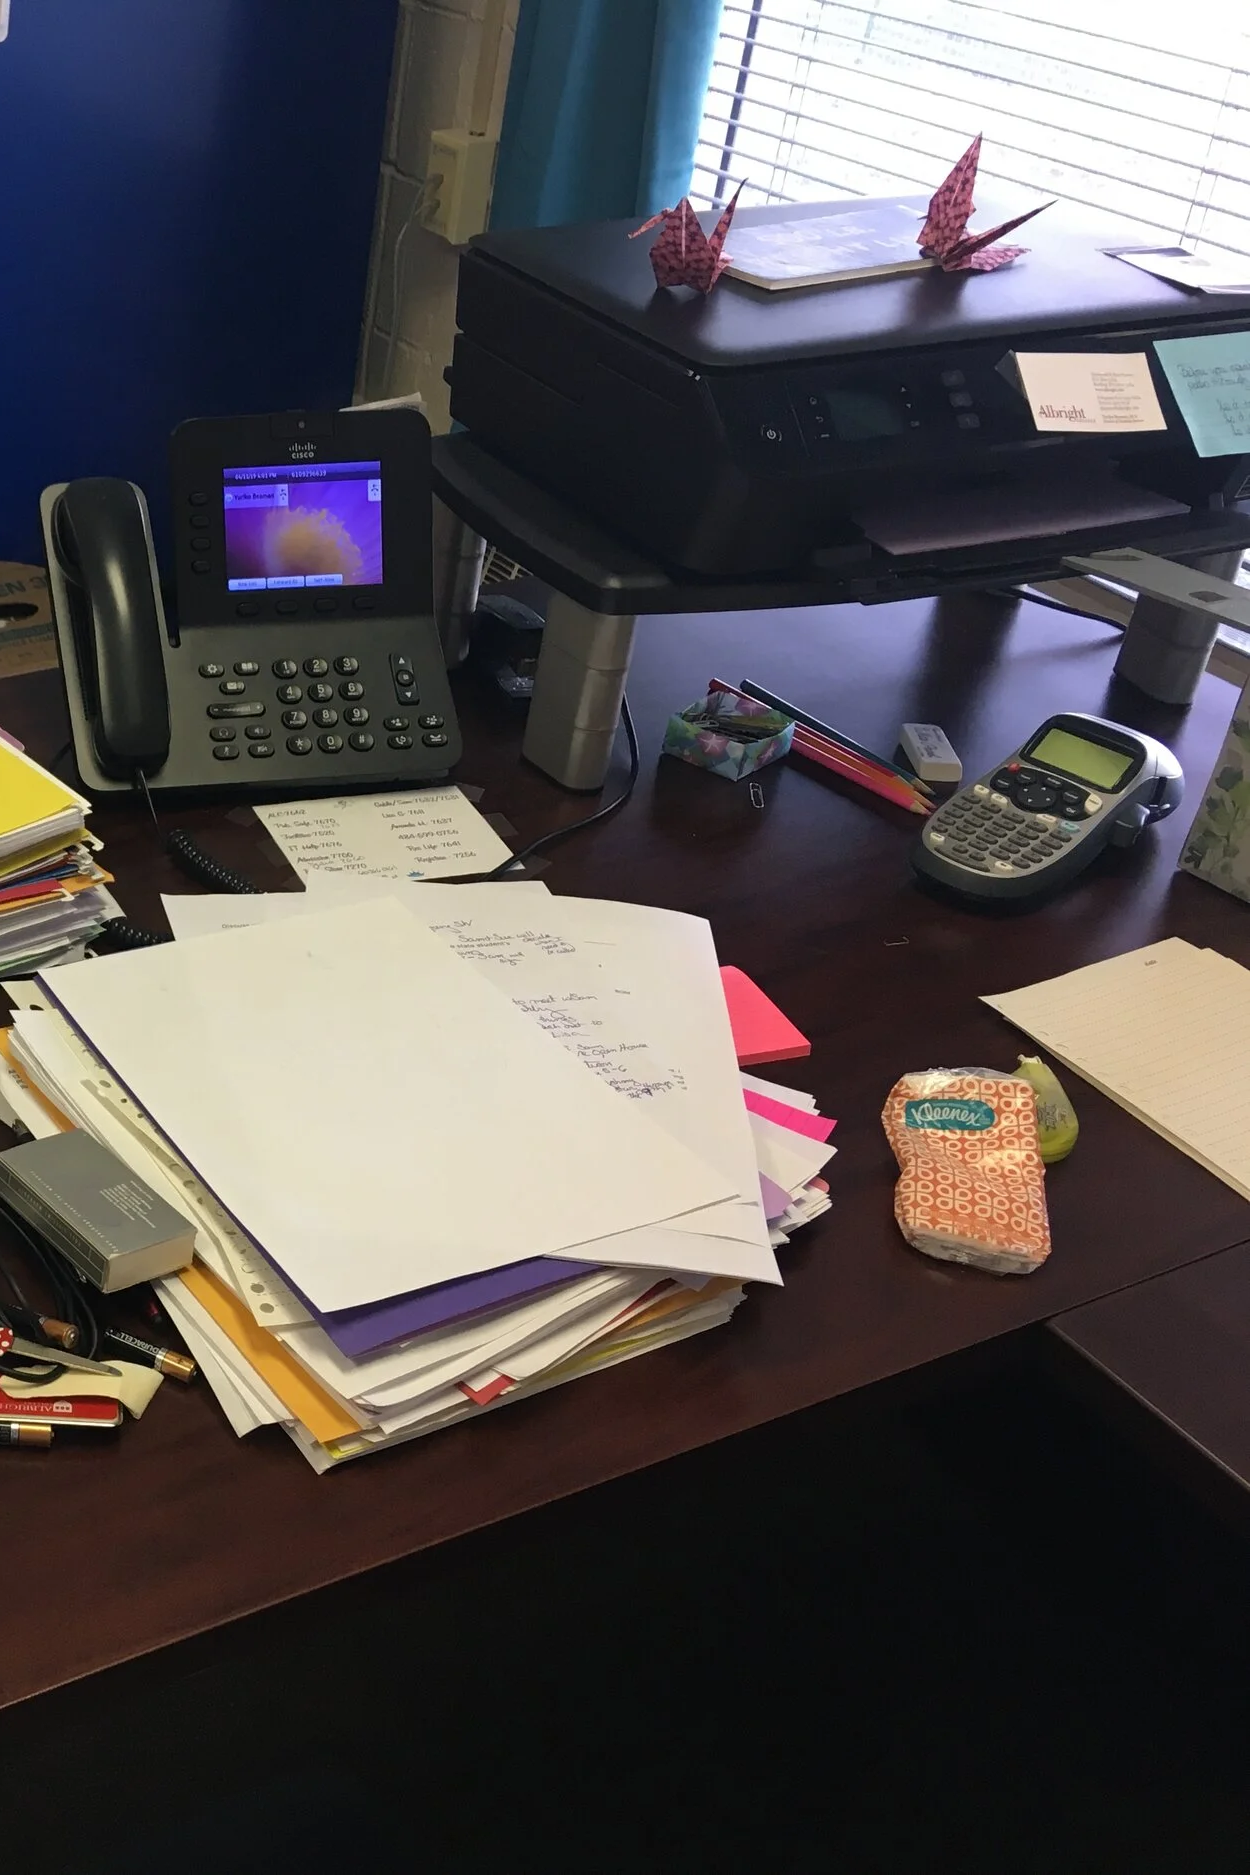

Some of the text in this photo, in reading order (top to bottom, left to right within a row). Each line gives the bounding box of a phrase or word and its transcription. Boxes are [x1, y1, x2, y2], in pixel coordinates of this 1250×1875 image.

[1038, 404, 1087, 422] Albright
[282, 660, 289, 670] 1
[312, 659, 320, 669] 2
[342, 657, 351, 667] 3
[286, 686, 293, 696] 4
[316, 684, 325, 694] 5
[347, 682, 356, 692] 6
[290, 711, 298, 721] 7
[322, 709, 330, 719] 8
[352, 708, 361, 718] 9
[326, 736, 335, 746] 0
[911, 1102, 981, 1127] Kleenex
[120, 1331, 161, 1354] DURACELL
